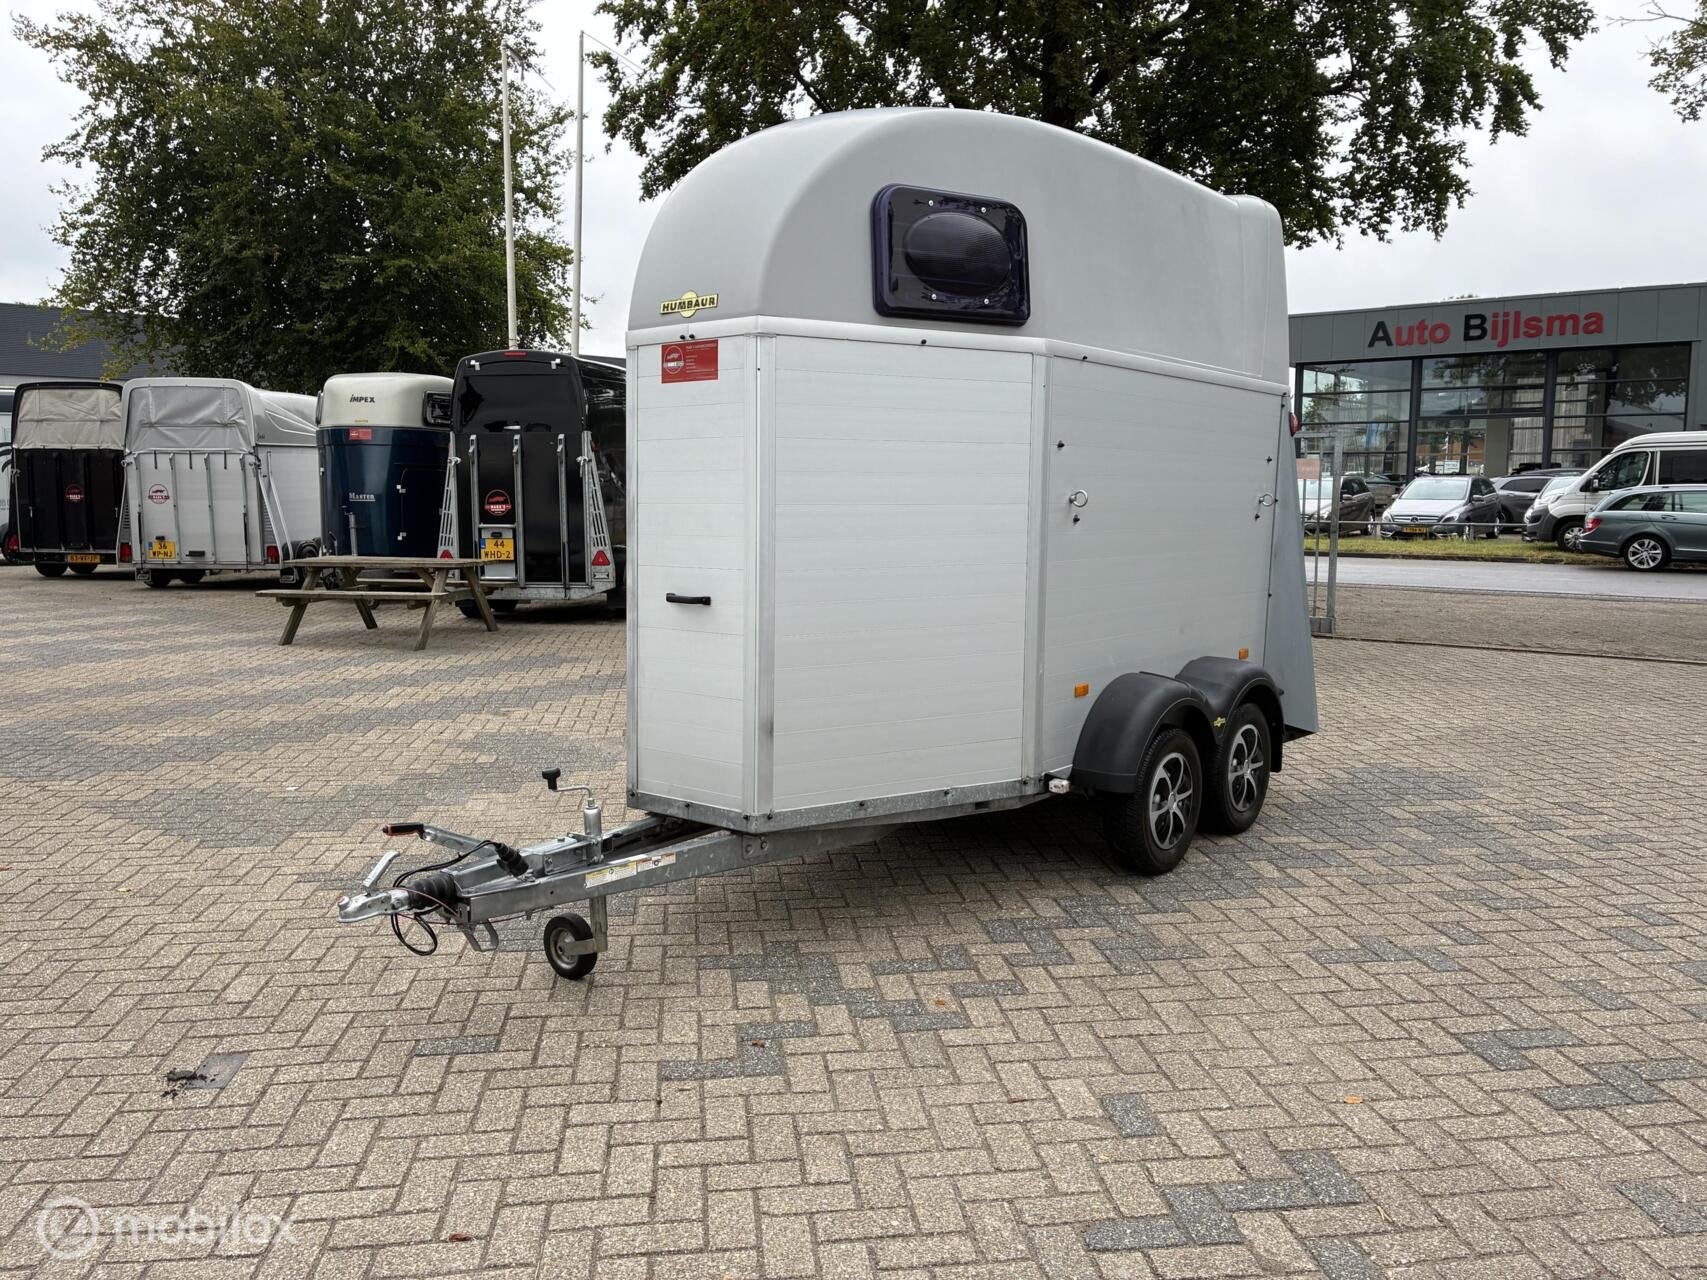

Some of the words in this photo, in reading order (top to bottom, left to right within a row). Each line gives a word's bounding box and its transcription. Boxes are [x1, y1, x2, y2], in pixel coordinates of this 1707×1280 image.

[662, 296, 716, 312] HUMBAUR
[1367, 320, 1450, 348] Auto
[1463, 311, 1604, 348] Bijlsma
[493, 540, 505, 549] 44
[484, 550, 511, 559] WHD-2
